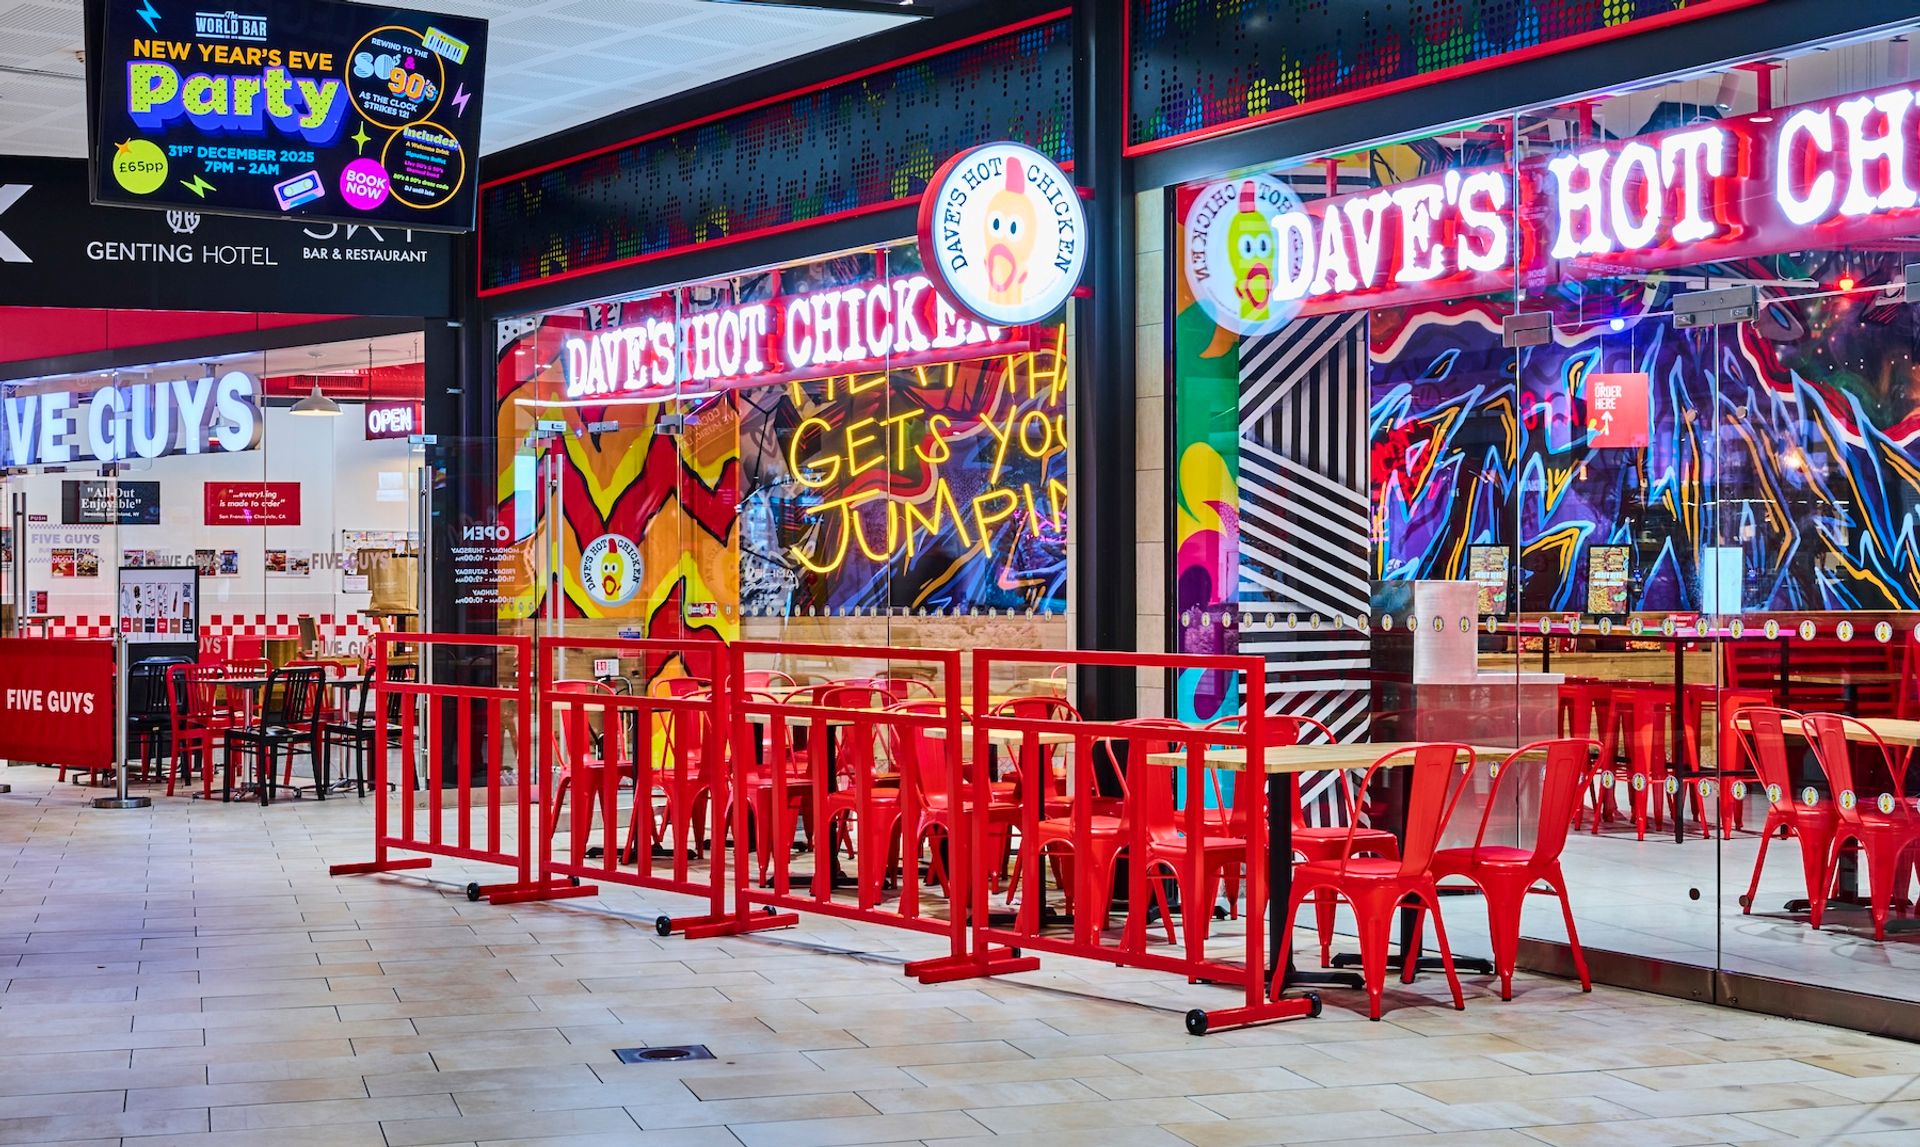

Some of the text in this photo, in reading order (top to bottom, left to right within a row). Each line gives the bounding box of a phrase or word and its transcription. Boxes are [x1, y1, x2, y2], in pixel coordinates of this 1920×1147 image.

[196, 17, 267, 37] WORLD BAR
[133, 39, 333, 72] NEW YEAR'S EVE
[371, 37, 429, 59] REWIND TO THE
[404, 56, 416, 70] &
[128, 61, 343, 138] Party
[359, 90, 419, 112] AS THE CLOCK
[363, 100, 410, 119] STRIKES 12!
[402, 126, 460, 149] Includes:
[197, 146, 277, 162] DECEMBER
[279, 150, 315, 163] 2025
[119, 160, 164, 173] £65pp
[204, 161, 234, 174] 7PM
[248, 162, 280, 176] 2AM
[346, 169, 388, 190] BOOK
[345, 181, 382, 200] NOW
[1270, 170, 1508, 302] DAVE'S
[1548, 125, 1725, 260] HOT
[1775, 88, 1920, 226] CH
[944, 156, 1075, 275] DAVE'S HOT CHICKEN
[86, 241, 279, 267] GENTING HOTEL
[302, 246, 428, 263] BAR & RESTAURANT
[565, 317, 676, 399] DAVE'S
[681, 302, 768, 381] HOT
[1594, 385, 1622, 398] ORDER
[1594, 398, 1617, 410] HERE
[88, 370, 260, 462] GUYS
[368, 406, 413, 434] OPEN
[789, 407, 952, 488] GETS
[81, 498, 142, 511] Enjoyble"
[227, 499, 249, 508] made
[250, 500, 260, 508] to
[31, 534, 101, 544] FIVE GUYS
[312, 552, 390, 571] FIVE GUYS
[584, 538, 641, 592] DAVE'S HOT CHICKEN
[348, 640, 376, 657] GUY
[6, 688, 95, 715] FIVE GUYS
